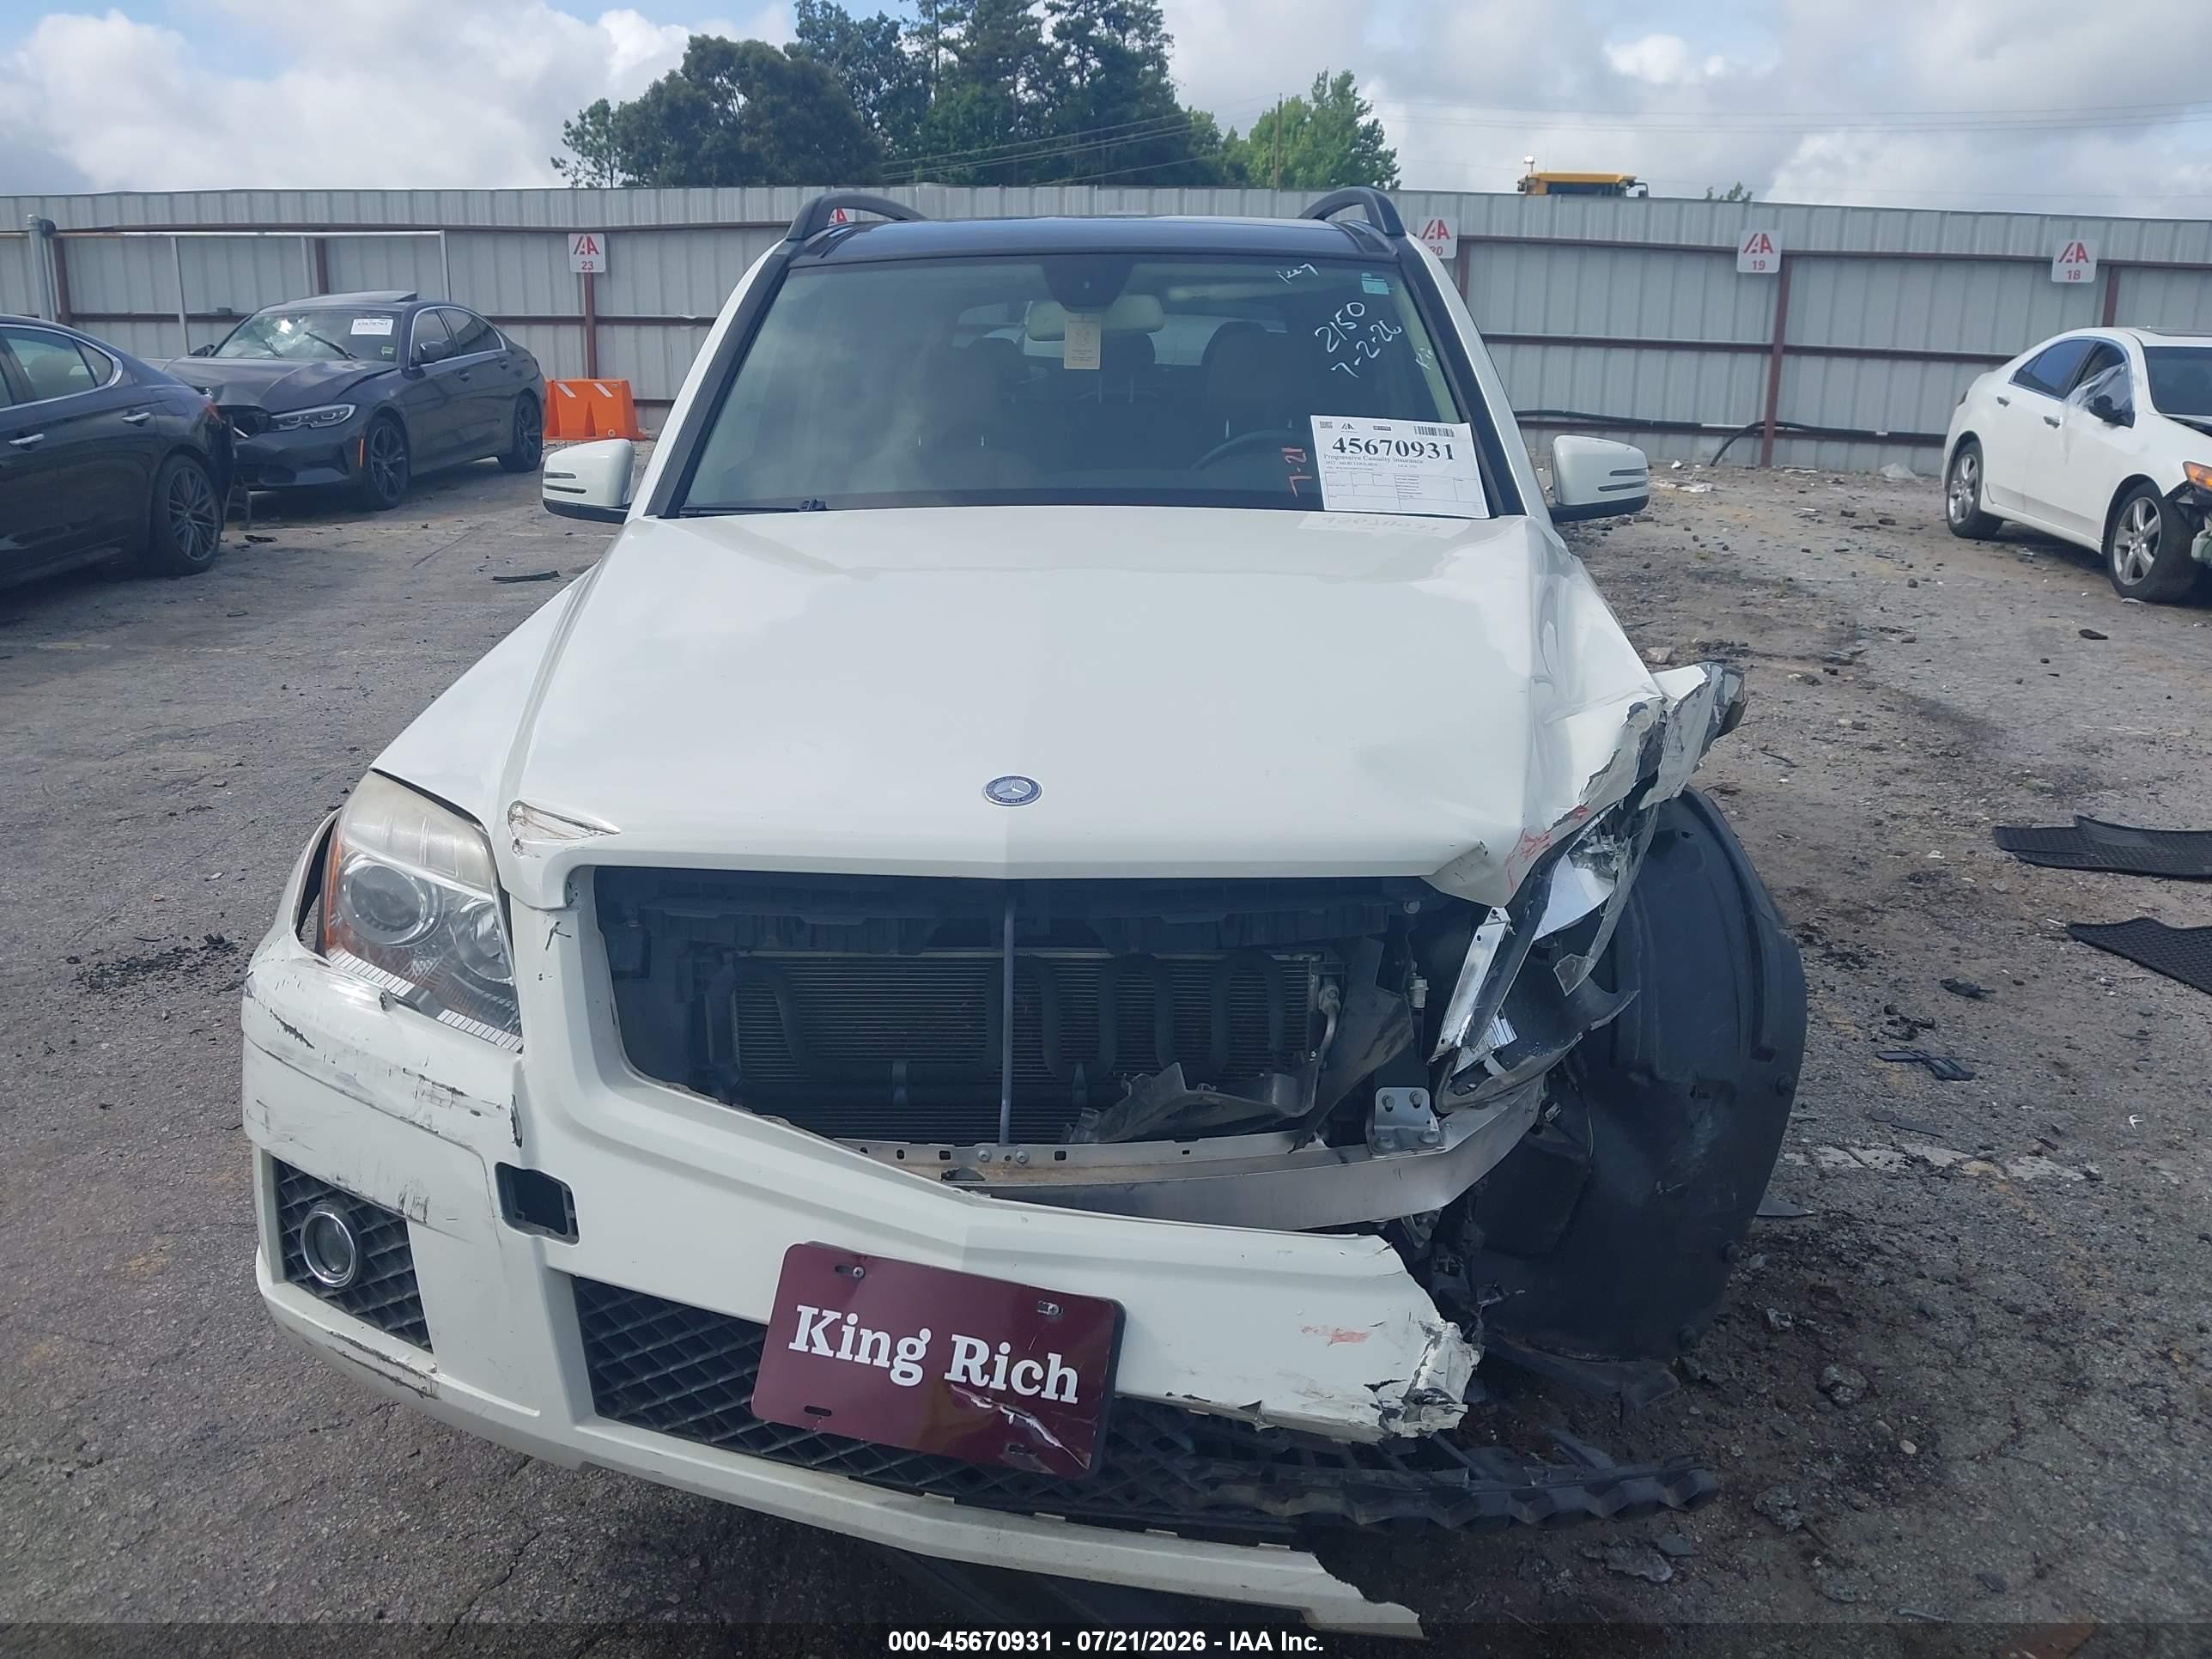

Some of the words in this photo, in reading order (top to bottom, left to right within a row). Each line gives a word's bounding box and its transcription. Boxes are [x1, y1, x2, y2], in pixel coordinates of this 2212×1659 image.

[581, 260, 594, 270] 23
[1752, 259, 1765, 271] 19
[2067, 269, 2081, 281] 18
[1315, 301, 1365, 353] 2150
[1332, 436, 1456, 461] 45670931
[788, 1304, 932, 1387] King
[944, 1334, 1079, 1404] Rich
